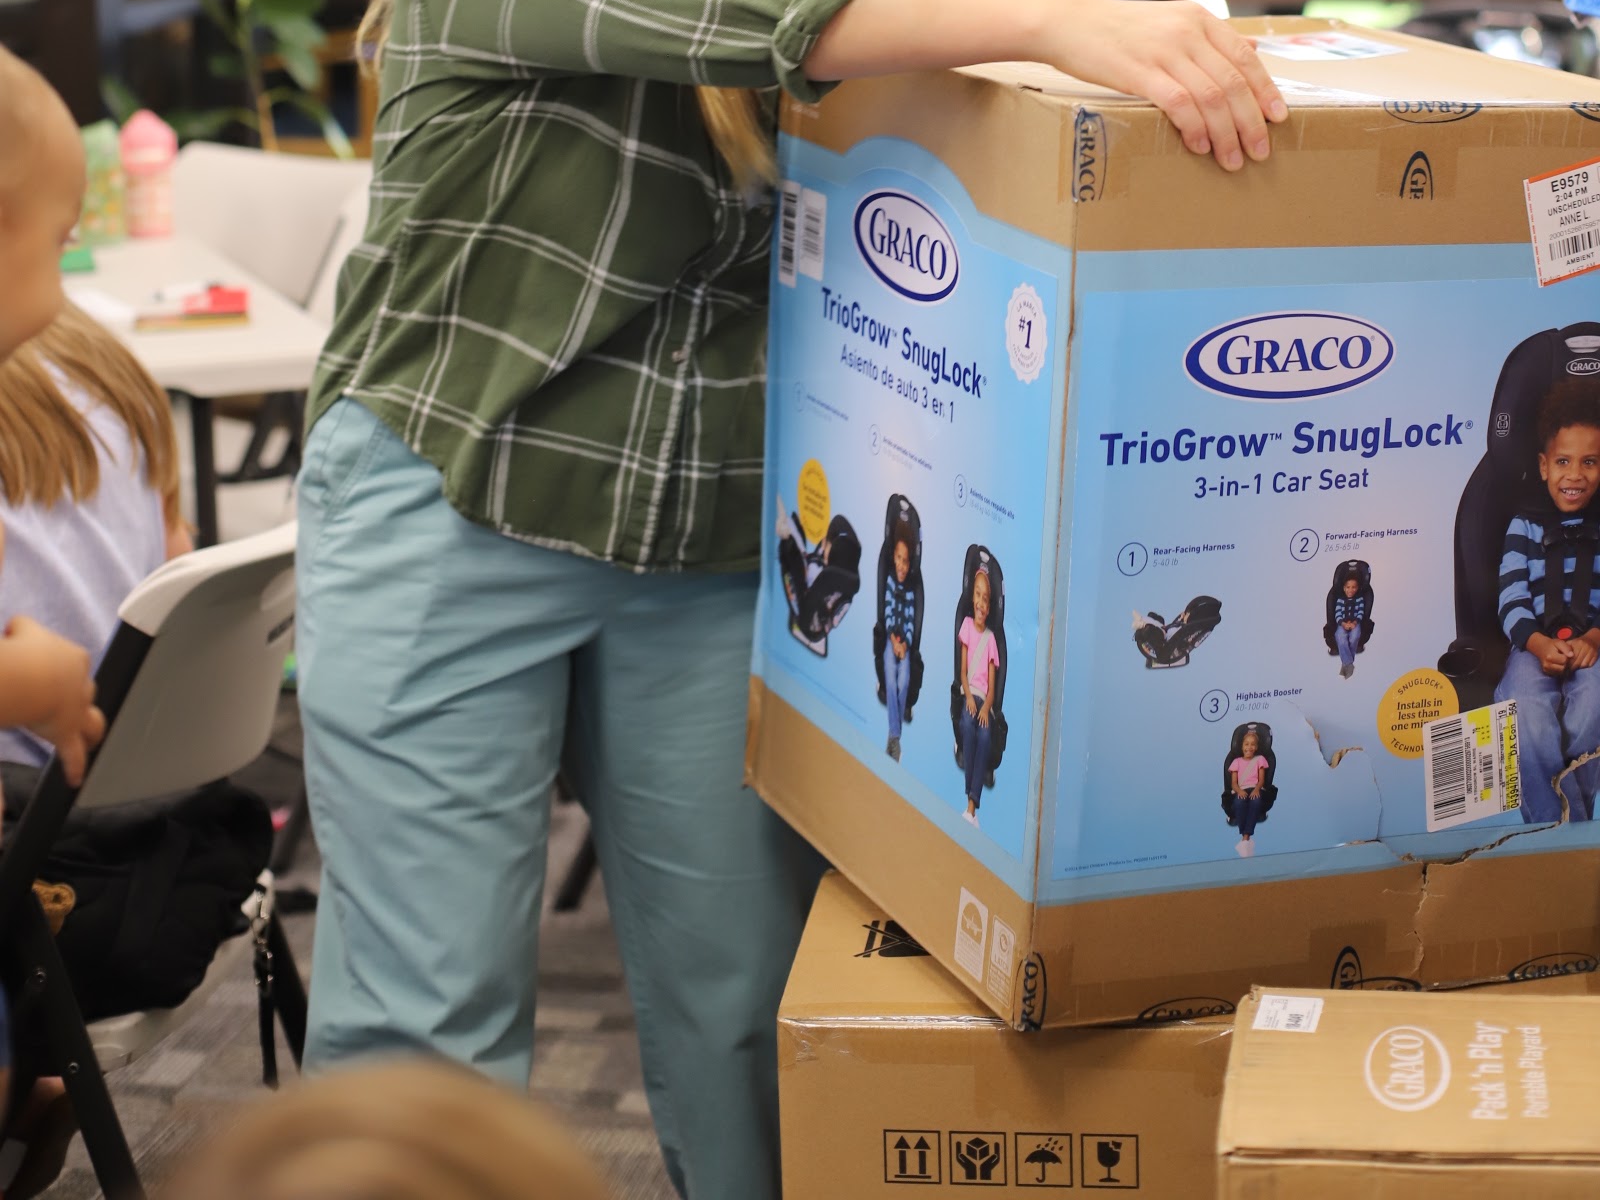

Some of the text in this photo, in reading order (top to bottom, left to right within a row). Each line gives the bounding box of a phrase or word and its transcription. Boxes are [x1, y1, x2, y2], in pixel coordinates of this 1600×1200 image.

[1551, 171, 1589, 192] E9579
[1556, 186, 1588, 203] 2:04 PM
[1547, 193, 1600, 217] UNSCHEDULED
[1560, 210, 1582, 227] ANNE
[869, 206, 948, 282] GRACO
[1566, 252, 1595, 266] AMBIENT
[1018, 315, 1032, 349] #1
[1216, 334, 1372, 376] GRACO
[1570, 362, 1600, 371] GRACO
[840, 343, 879, 380] Asiento
[881, 369, 894, 390] de
[897, 378, 919, 404] auto
[922, 386, 928, 409] 3
[949, 401, 954, 423] 1
[872, 431, 878, 448] 2
[958, 482, 964, 499] 3
[1194, 468, 1369, 498] 3-in-1 Car Seat
[1325, 527, 1418, 541] Forward-Facing Harness
[1153, 543, 1235, 556] Rear-Facing Harness
[1299, 537, 1309, 553] 2
[1128, 551, 1135, 567] 1
[1236, 687, 1303, 702] Highback Booster
[1210, 697, 1219, 714] 3
[1397, 698, 1443, 710] Installs in
[1398, 709, 1440, 721] less than
[1498, 709, 1506, 718] 19
[1391, 723, 1409, 731] one
[1511, 771, 1519, 809] 04394/01
[1466, 1025, 1510, 1060] Play
[1515, 1024, 1548, 1069] Playard
[1383, 1033, 1425, 1100] GRACO
[1470, 1082, 1508, 1119] Pack
